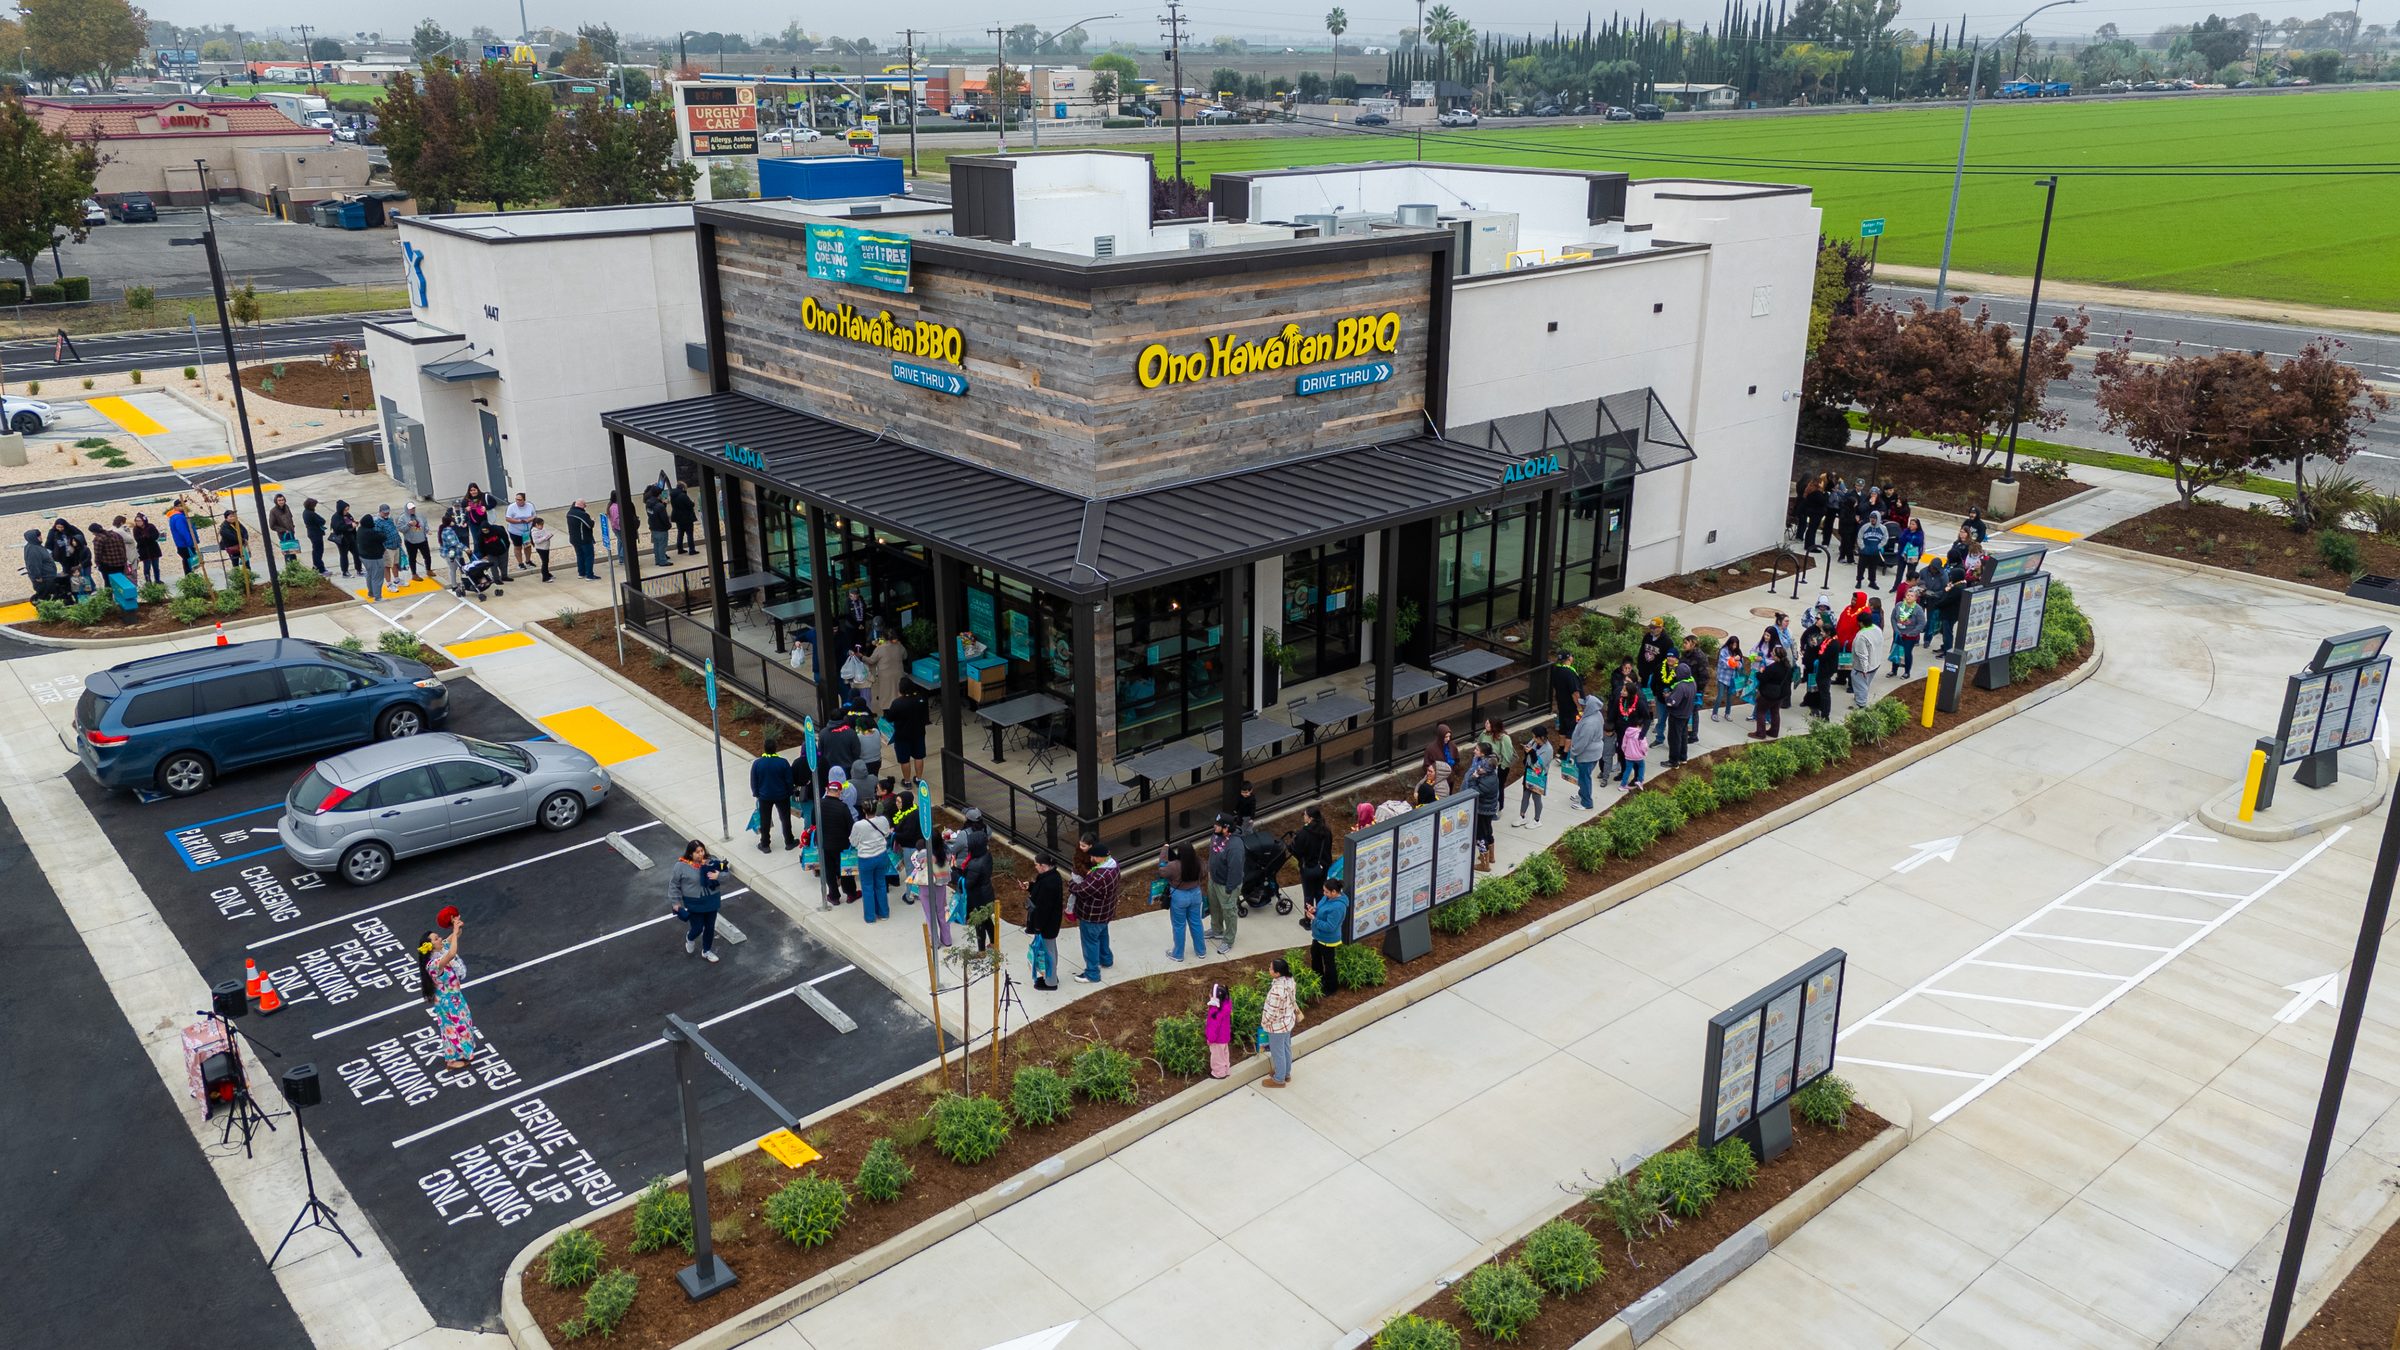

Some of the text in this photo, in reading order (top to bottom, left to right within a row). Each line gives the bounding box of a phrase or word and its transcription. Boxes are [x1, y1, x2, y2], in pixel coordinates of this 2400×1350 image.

[158, 114, 210, 130] Denny's
[695, 107, 747, 119] URGENT
[705, 119, 740, 130] CARE
[695, 139, 708, 148] Baz
[710, 136, 732, 144] Allergy,
[862, 252, 875, 260] GET
[874, 245, 879, 261] 1
[483, 304, 499, 321] 1447
[802, 296, 838, 336] Ono
[915, 320, 963, 366] BBQ
[1138, 343, 1206, 389] Ono
[1334, 311, 1401, 360] BBQ
[893, 365, 945, 389] DRIVE THRU
[1302, 368, 1370, 393] DRIVE THRU
[724, 441, 765, 472] ALOHA
[1503, 454, 1559, 484] ALOHA
[30, 681, 63, 704] ENTER
[175, 827, 222, 865] PARKING
[219, 828, 250, 844] NO
[240, 865, 301, 923] CHARGING
[290, 872, 326, 890] EV
[210, 886, 256, 920] ONLY
[330, 938, 394, 989] PICK UP
[352, 916, 422, 993] DRIVE THRU
[268, 965, 319, 1005] ONLY
[296, 948, 359, 1005] PARKING
[366, 1037, 439, 1106] PARKING
[402, 1025, 446, 1066] PICK
[434, 1069, 477, 1089] UP
[470, 1043, 522, 1091] THRU
[336, 1058, 394, 1106] ONLY
[488, 1129, 573, 1204] PICK UP
[510, 1098, 624, 1206] DRIVE THRU
[418, 1168, 484, 1226] ONLY
[450, 1144, 533, 1227] PARKING
